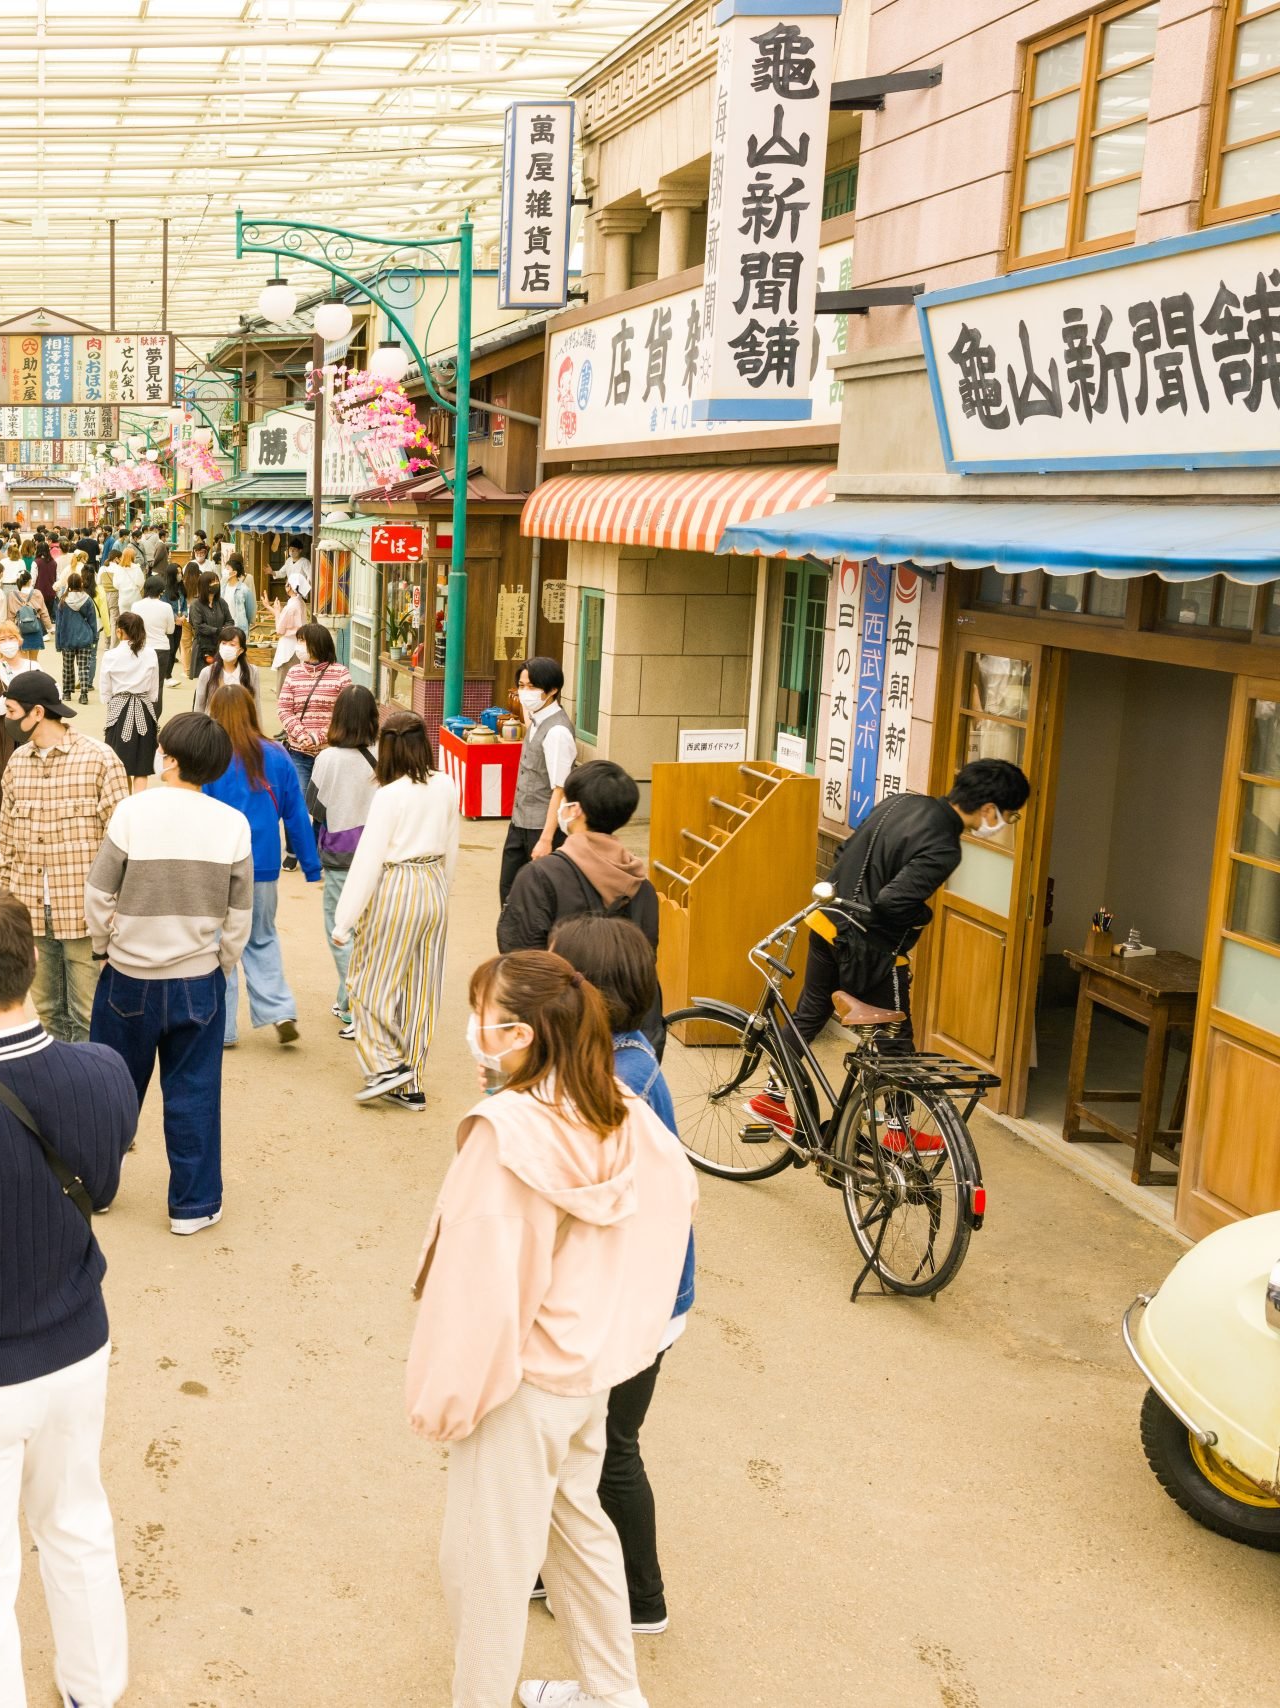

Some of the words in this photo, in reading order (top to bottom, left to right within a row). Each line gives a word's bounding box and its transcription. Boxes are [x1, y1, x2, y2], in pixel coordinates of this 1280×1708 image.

[145, 347, 163, 401] 夢見堂
[373, 528, 420, 561] たばこ
[825, 603, 855, 811] 日の丸日報
[852, 611, 887, 820] 西武スポーツ
